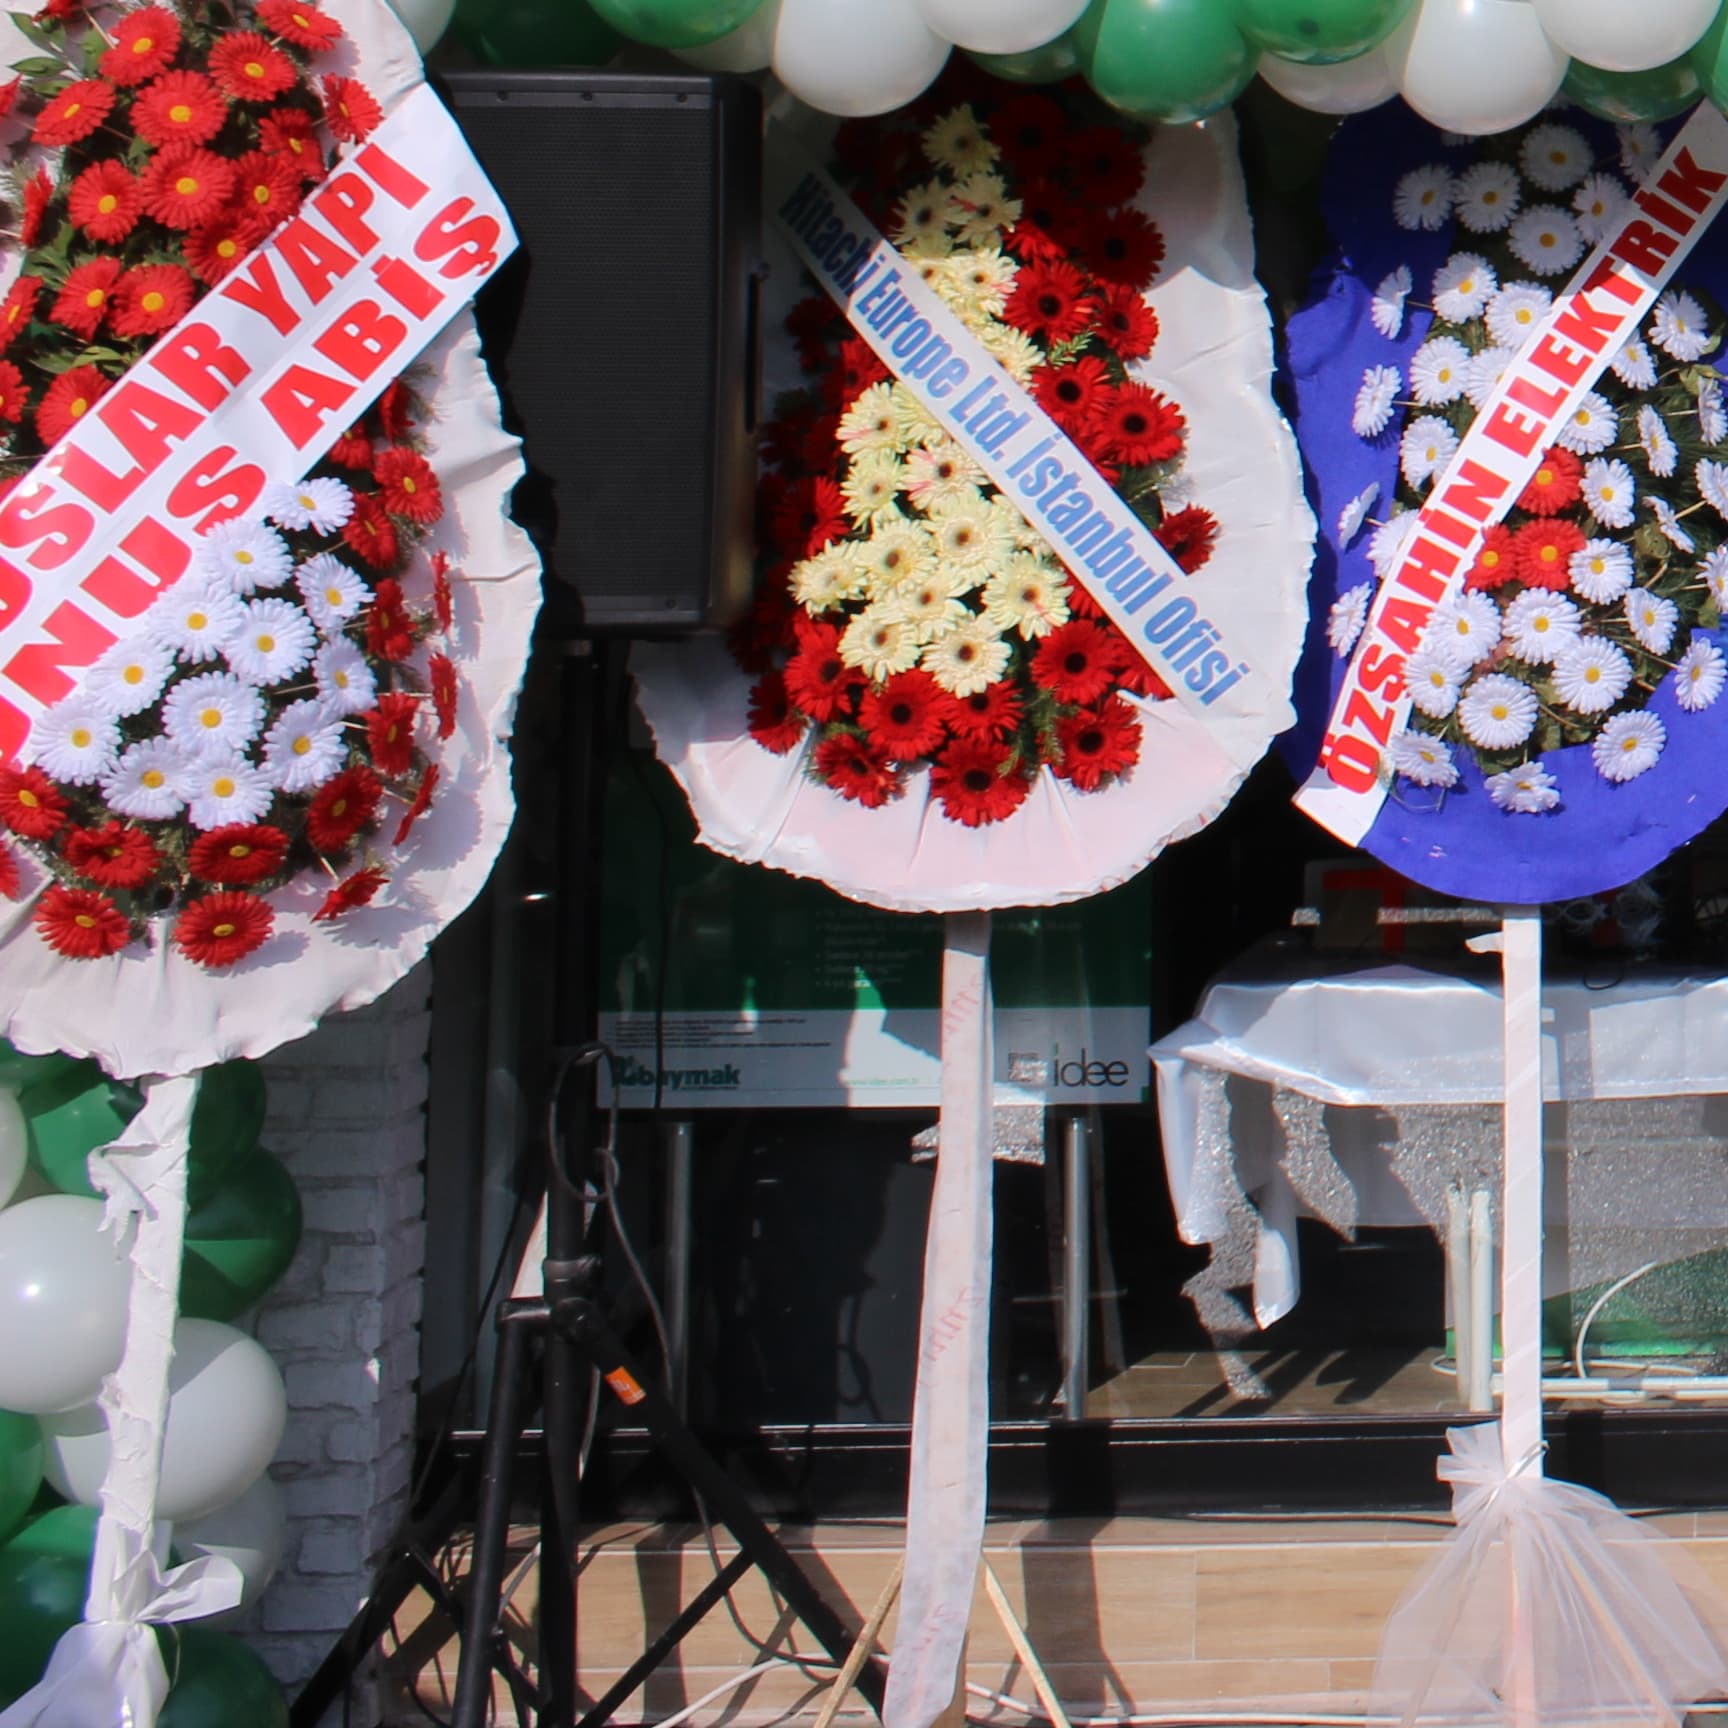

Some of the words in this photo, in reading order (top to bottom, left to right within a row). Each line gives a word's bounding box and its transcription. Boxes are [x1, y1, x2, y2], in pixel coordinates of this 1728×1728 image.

[0, 321, 251, 634] SLAR
[222, 143, 430, 339] YAPI
[776, 176, 887, 296] Hitachi
[855, 261, 970, 400] Europe
[947, 373, 1033, 462] Ltd.
[1004, 432, 1162, 617] İstanbul
[1143, 598, 1251, 706] Ofisi
[1484, 147, 1728, 461] ELEKTRİK
[1053, 1043, 1130, 1088] idee
